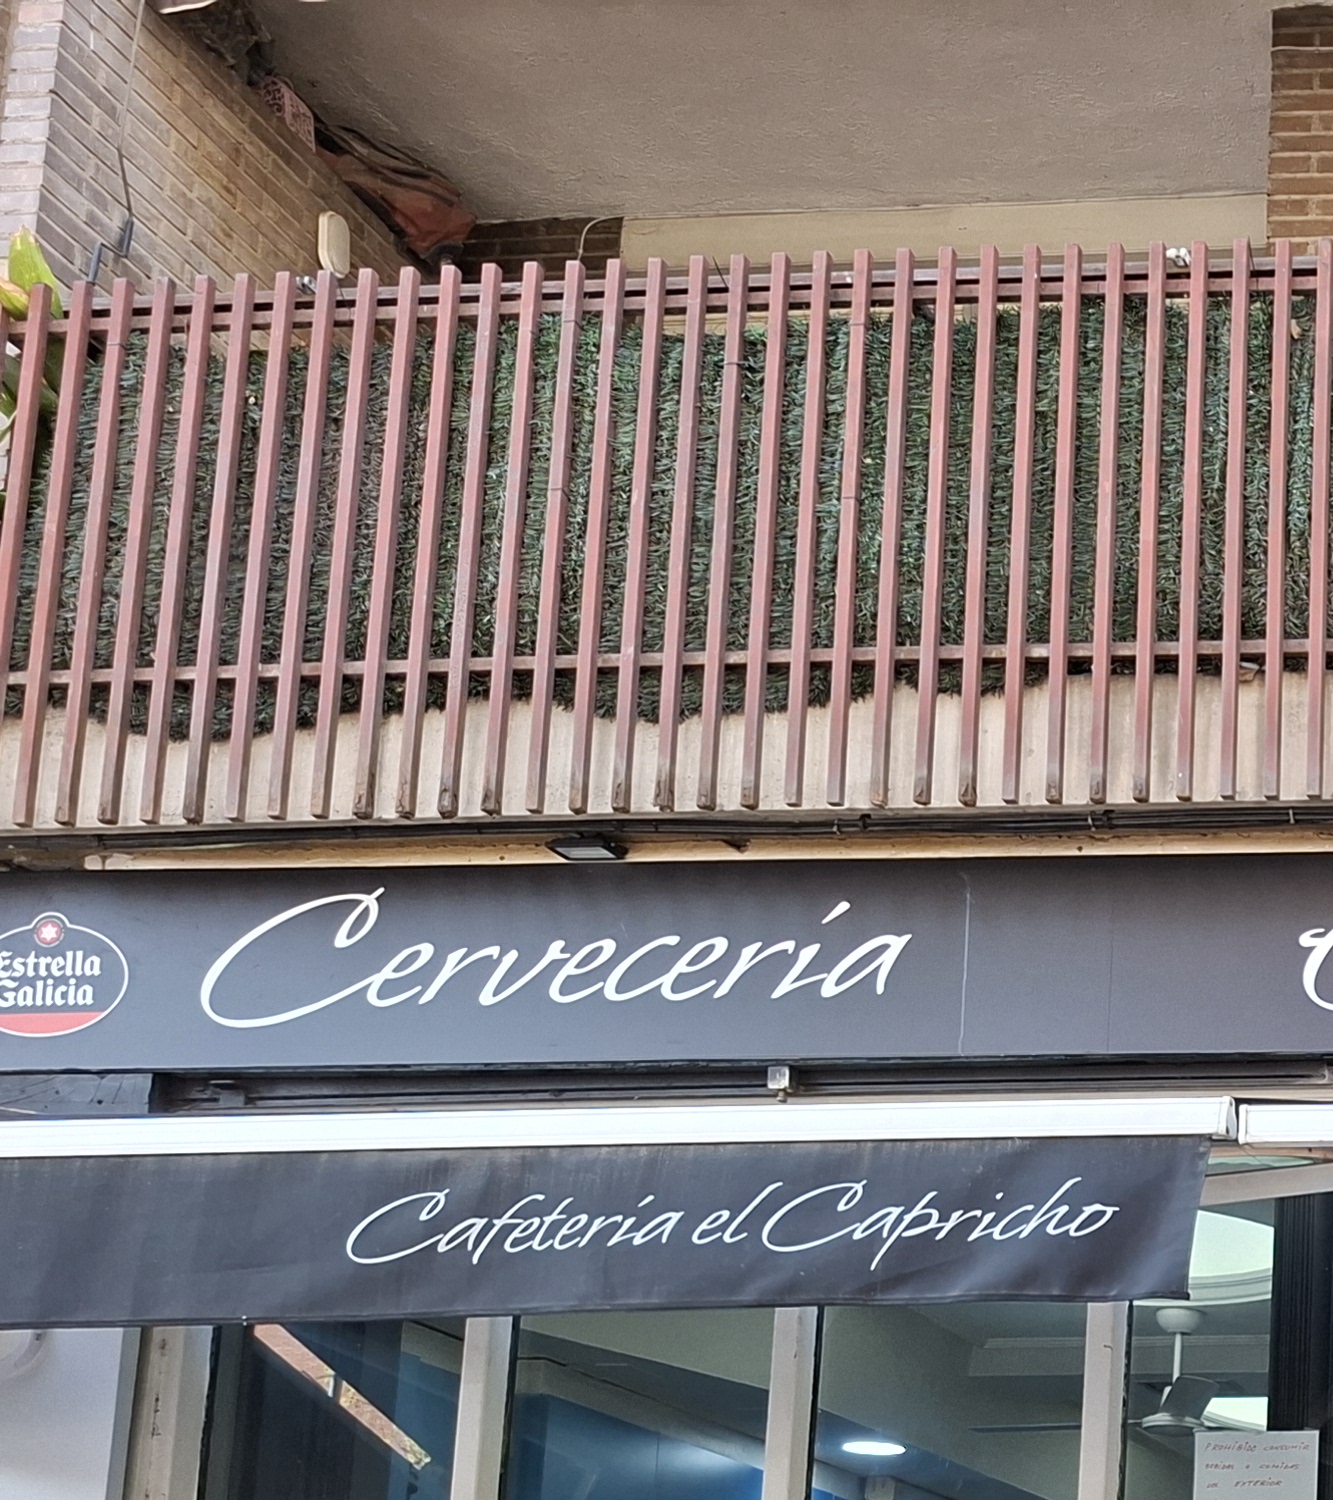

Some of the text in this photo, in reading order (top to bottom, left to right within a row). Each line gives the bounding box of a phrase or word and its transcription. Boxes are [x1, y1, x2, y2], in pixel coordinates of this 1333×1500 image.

[0, 950, 102, 978] Estrella
[200, 886, 913, 1030] Cervecería
[346, 1177, 1120, 1271] Cafetería el Capricho
